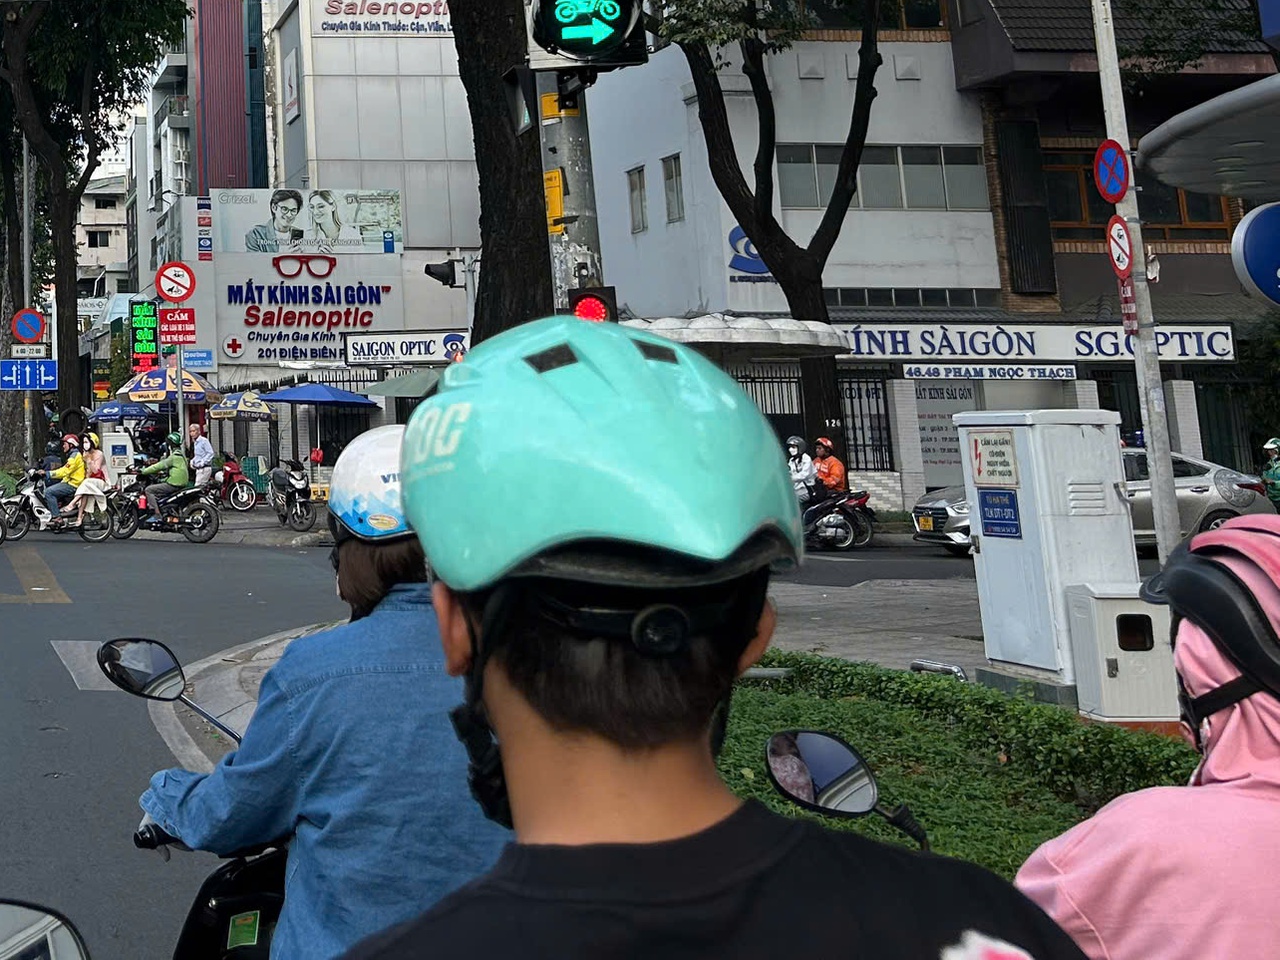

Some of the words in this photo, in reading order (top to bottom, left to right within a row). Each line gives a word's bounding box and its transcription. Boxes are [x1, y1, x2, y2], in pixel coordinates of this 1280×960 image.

[227, 278, 265, 305] MẮT
[268, 280, 309, 305] KÍNH
[312, 281, 341, 305] SÀI
[345, 281, 381, 305] GÒN
[166, 310, 189, 321] CẤM
[244, 305, 374, 332] Salenoptic
[247, 331, 294, 345] Chuyên
[295, 331, 309, 342] Gia
[311, 331, 333, 342] Kính
[843, 324, 912, 355] ÍNH
[258, 348, 277, 359] 201
[279, 346, 308, 361] ĐIỆN
[310, 346, 337, 359] BIÊN
[352, 341, 395, 357] SAIGON
[400, 340, 436, 356] OPTIC
[141, 375, 163, 388] be
[944, 367, 984, 380] PHẠM
[988, 367, 1024, 380] NGỌC
[1027, 367, 1075, 380] THẠCH
[526, 533, 571, 594] 19
